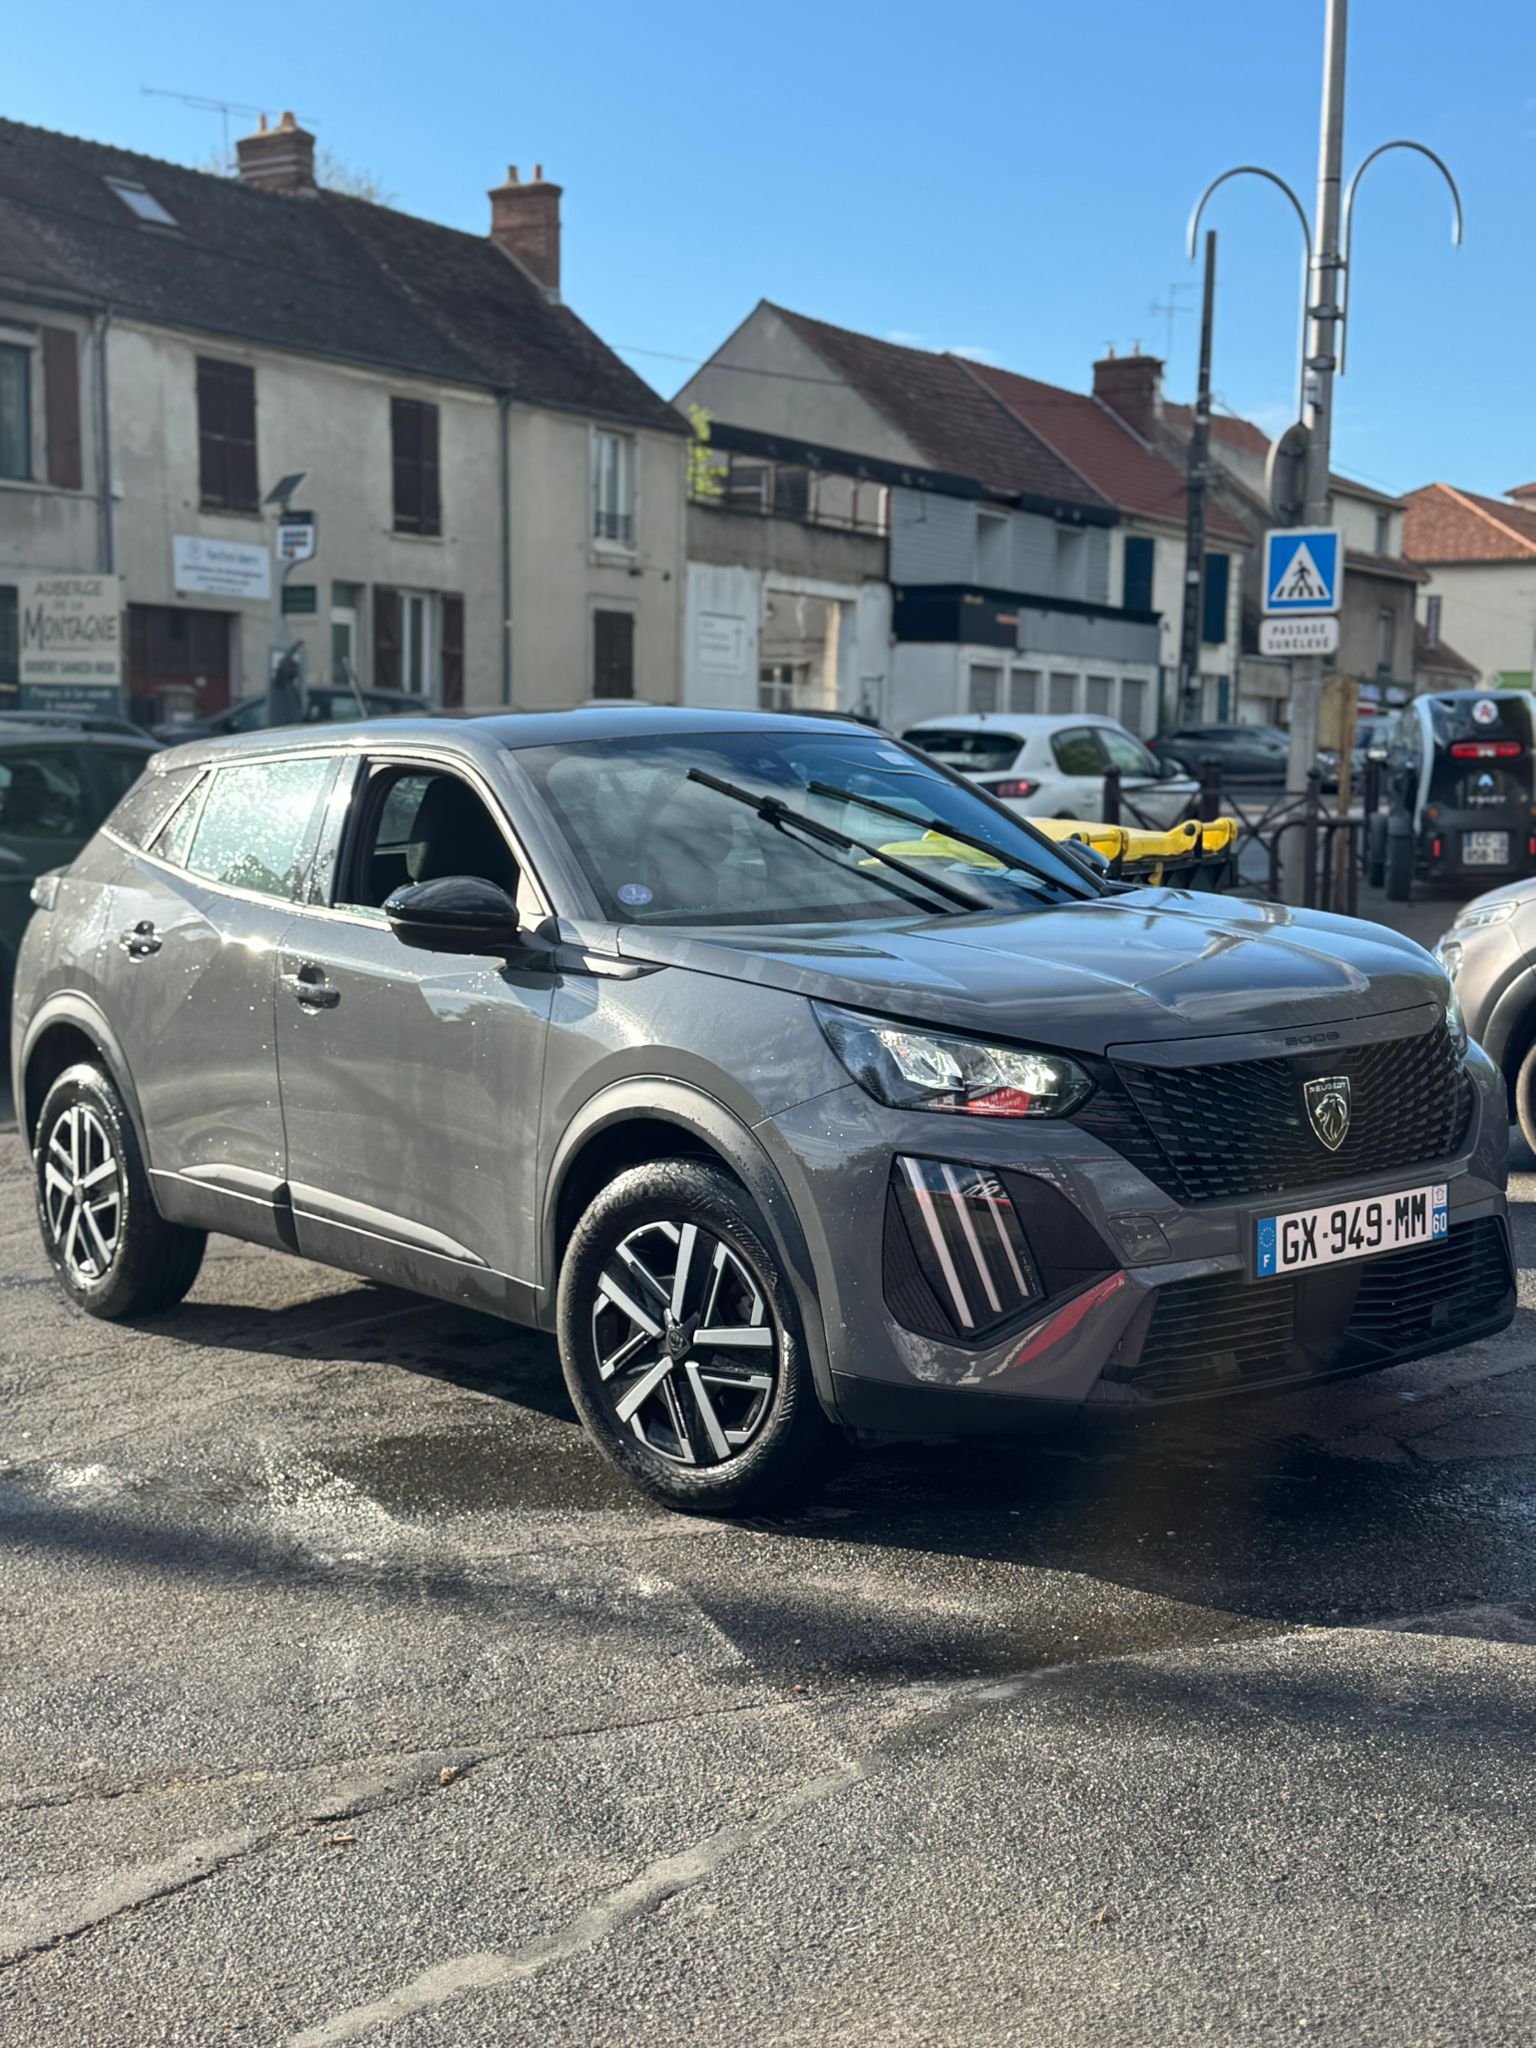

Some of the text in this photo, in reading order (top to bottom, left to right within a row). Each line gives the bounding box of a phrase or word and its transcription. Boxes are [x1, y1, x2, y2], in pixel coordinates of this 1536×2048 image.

[23, 602, 117, 651] MONTAGNE
[1272, 624, 1326, 635] PASSAGE
[1285, 1031, 1340, 1046] 2008
[1309, 1081, 1346, 1094] PEUGEOT
[1263, 1254, 1271, 1268] F
[1433, 1212, 1447, 1234] 60
